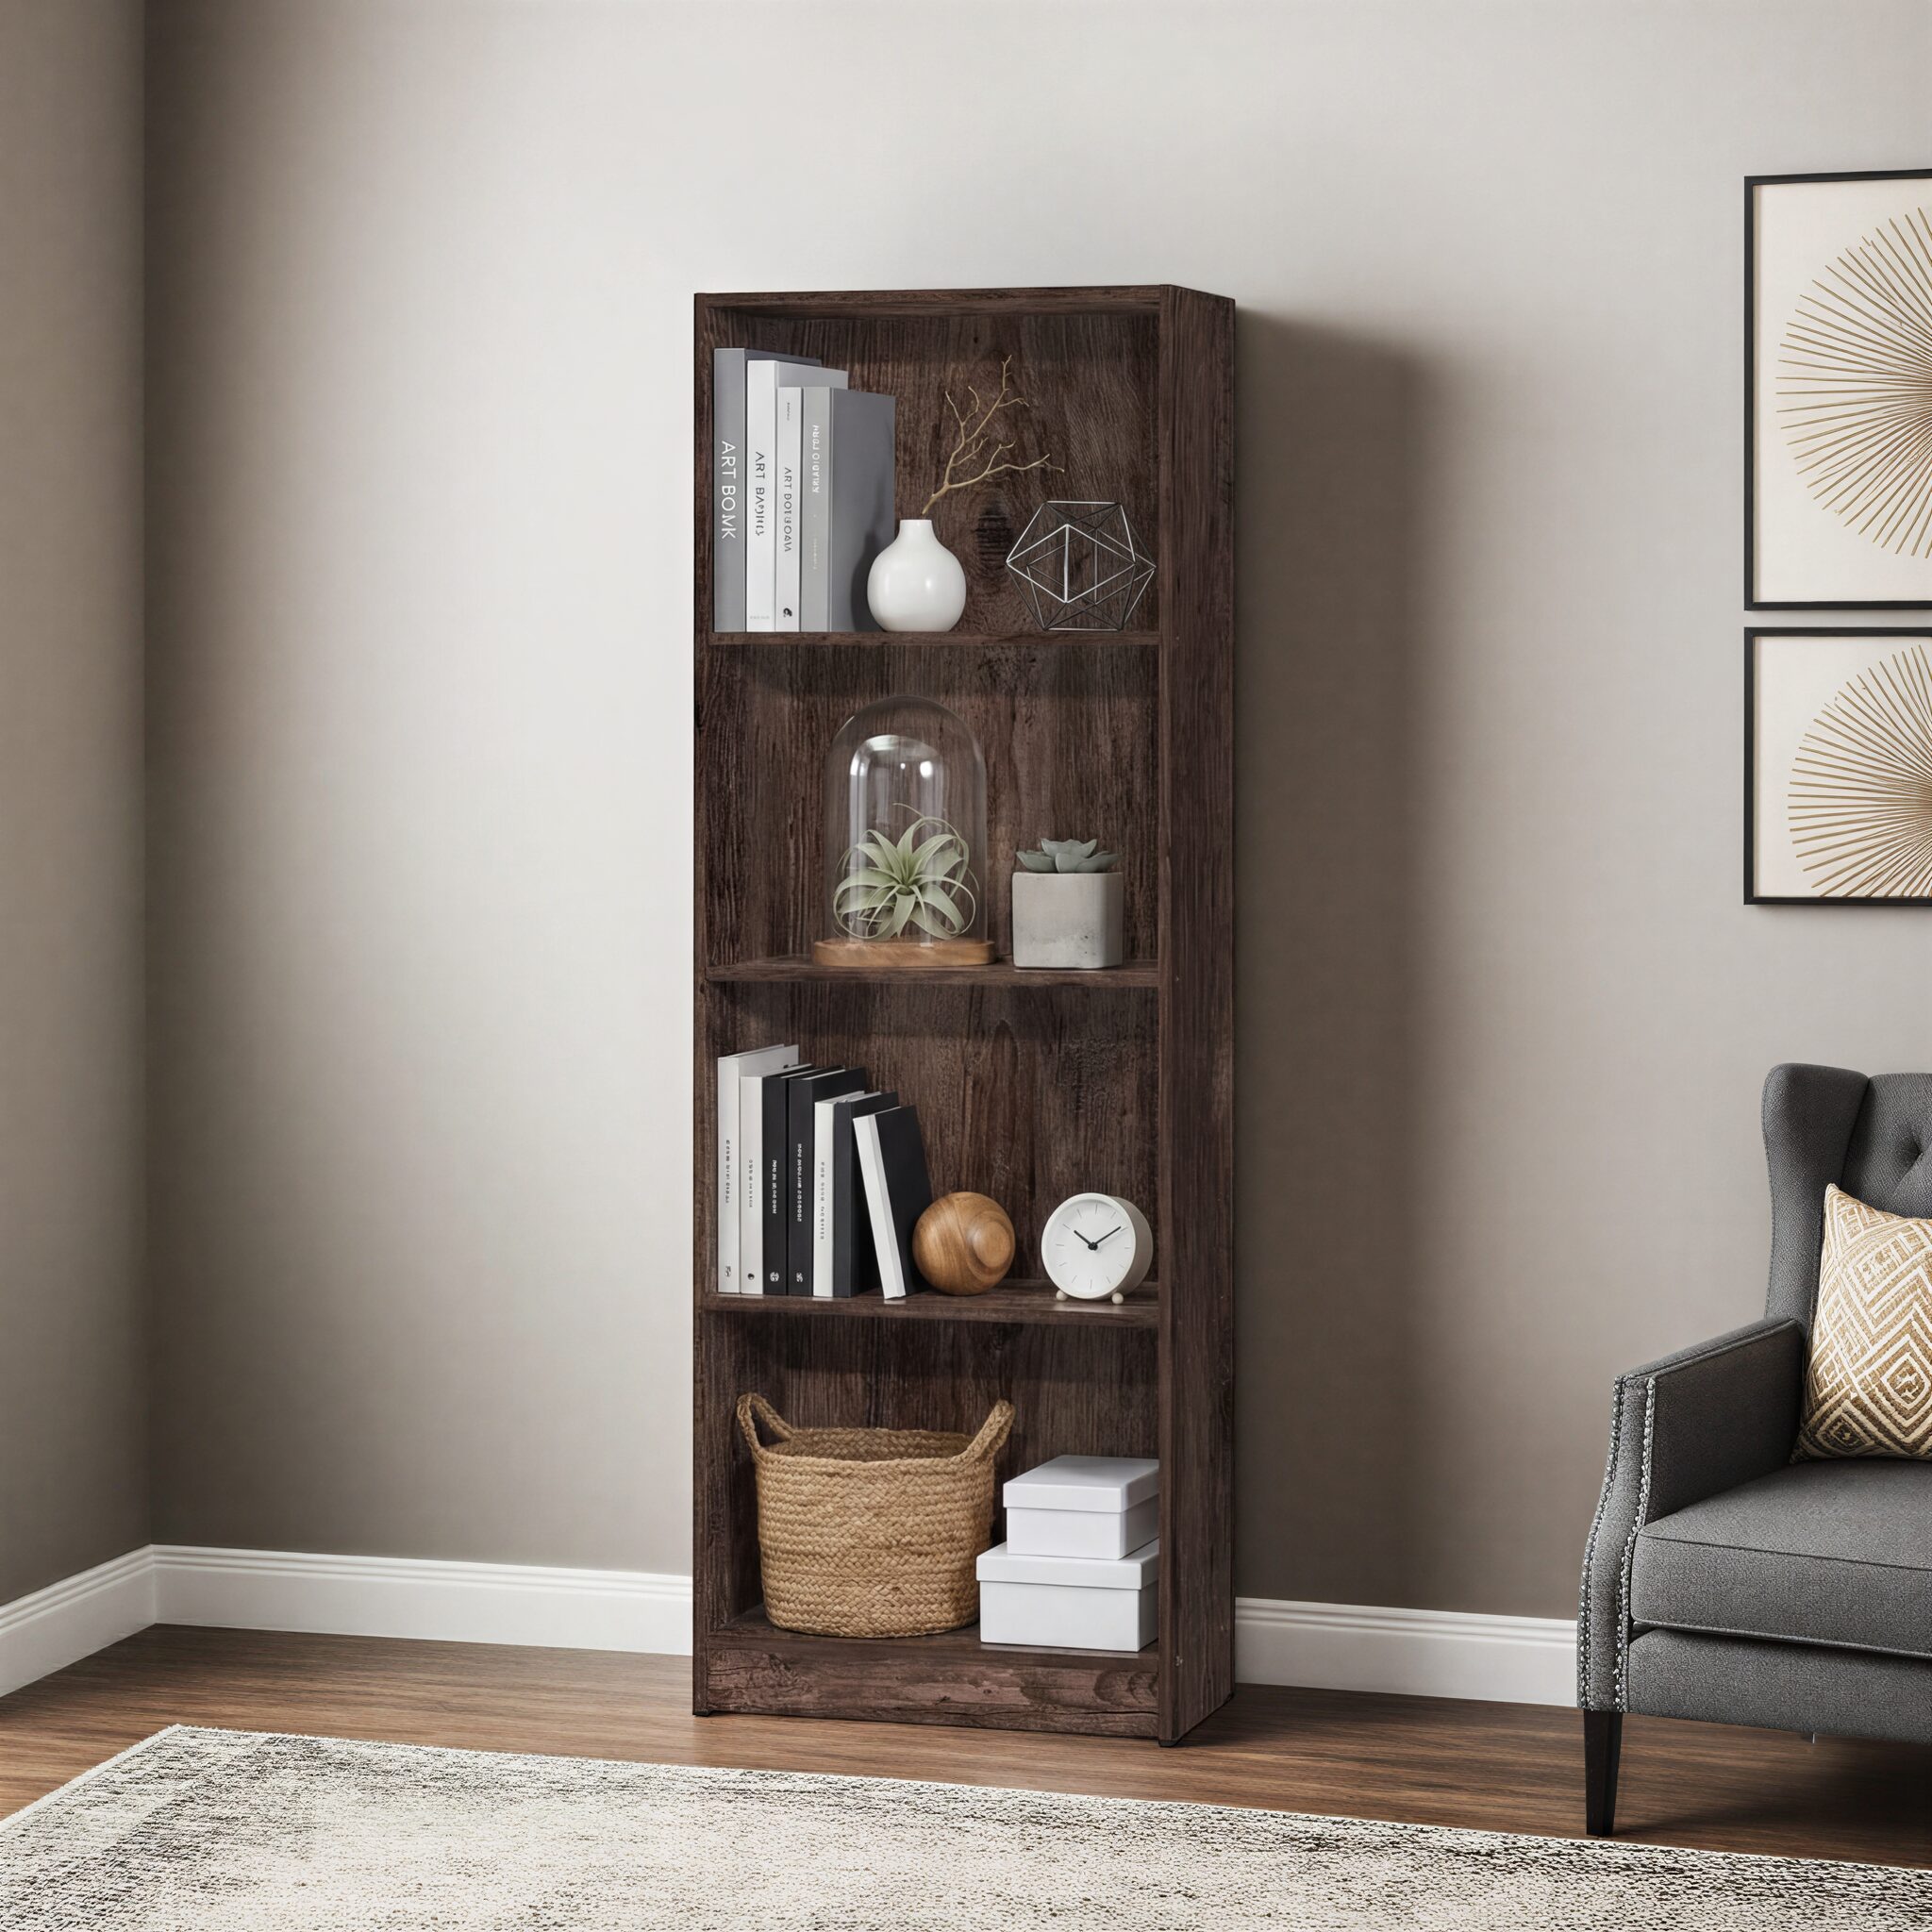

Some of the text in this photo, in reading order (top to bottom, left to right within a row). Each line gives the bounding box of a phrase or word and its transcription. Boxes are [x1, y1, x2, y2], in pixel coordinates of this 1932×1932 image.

[721, 440, 737, 479] ART
[755, 451, 766, 479] ART
[784, 467, 792, 490] ART
